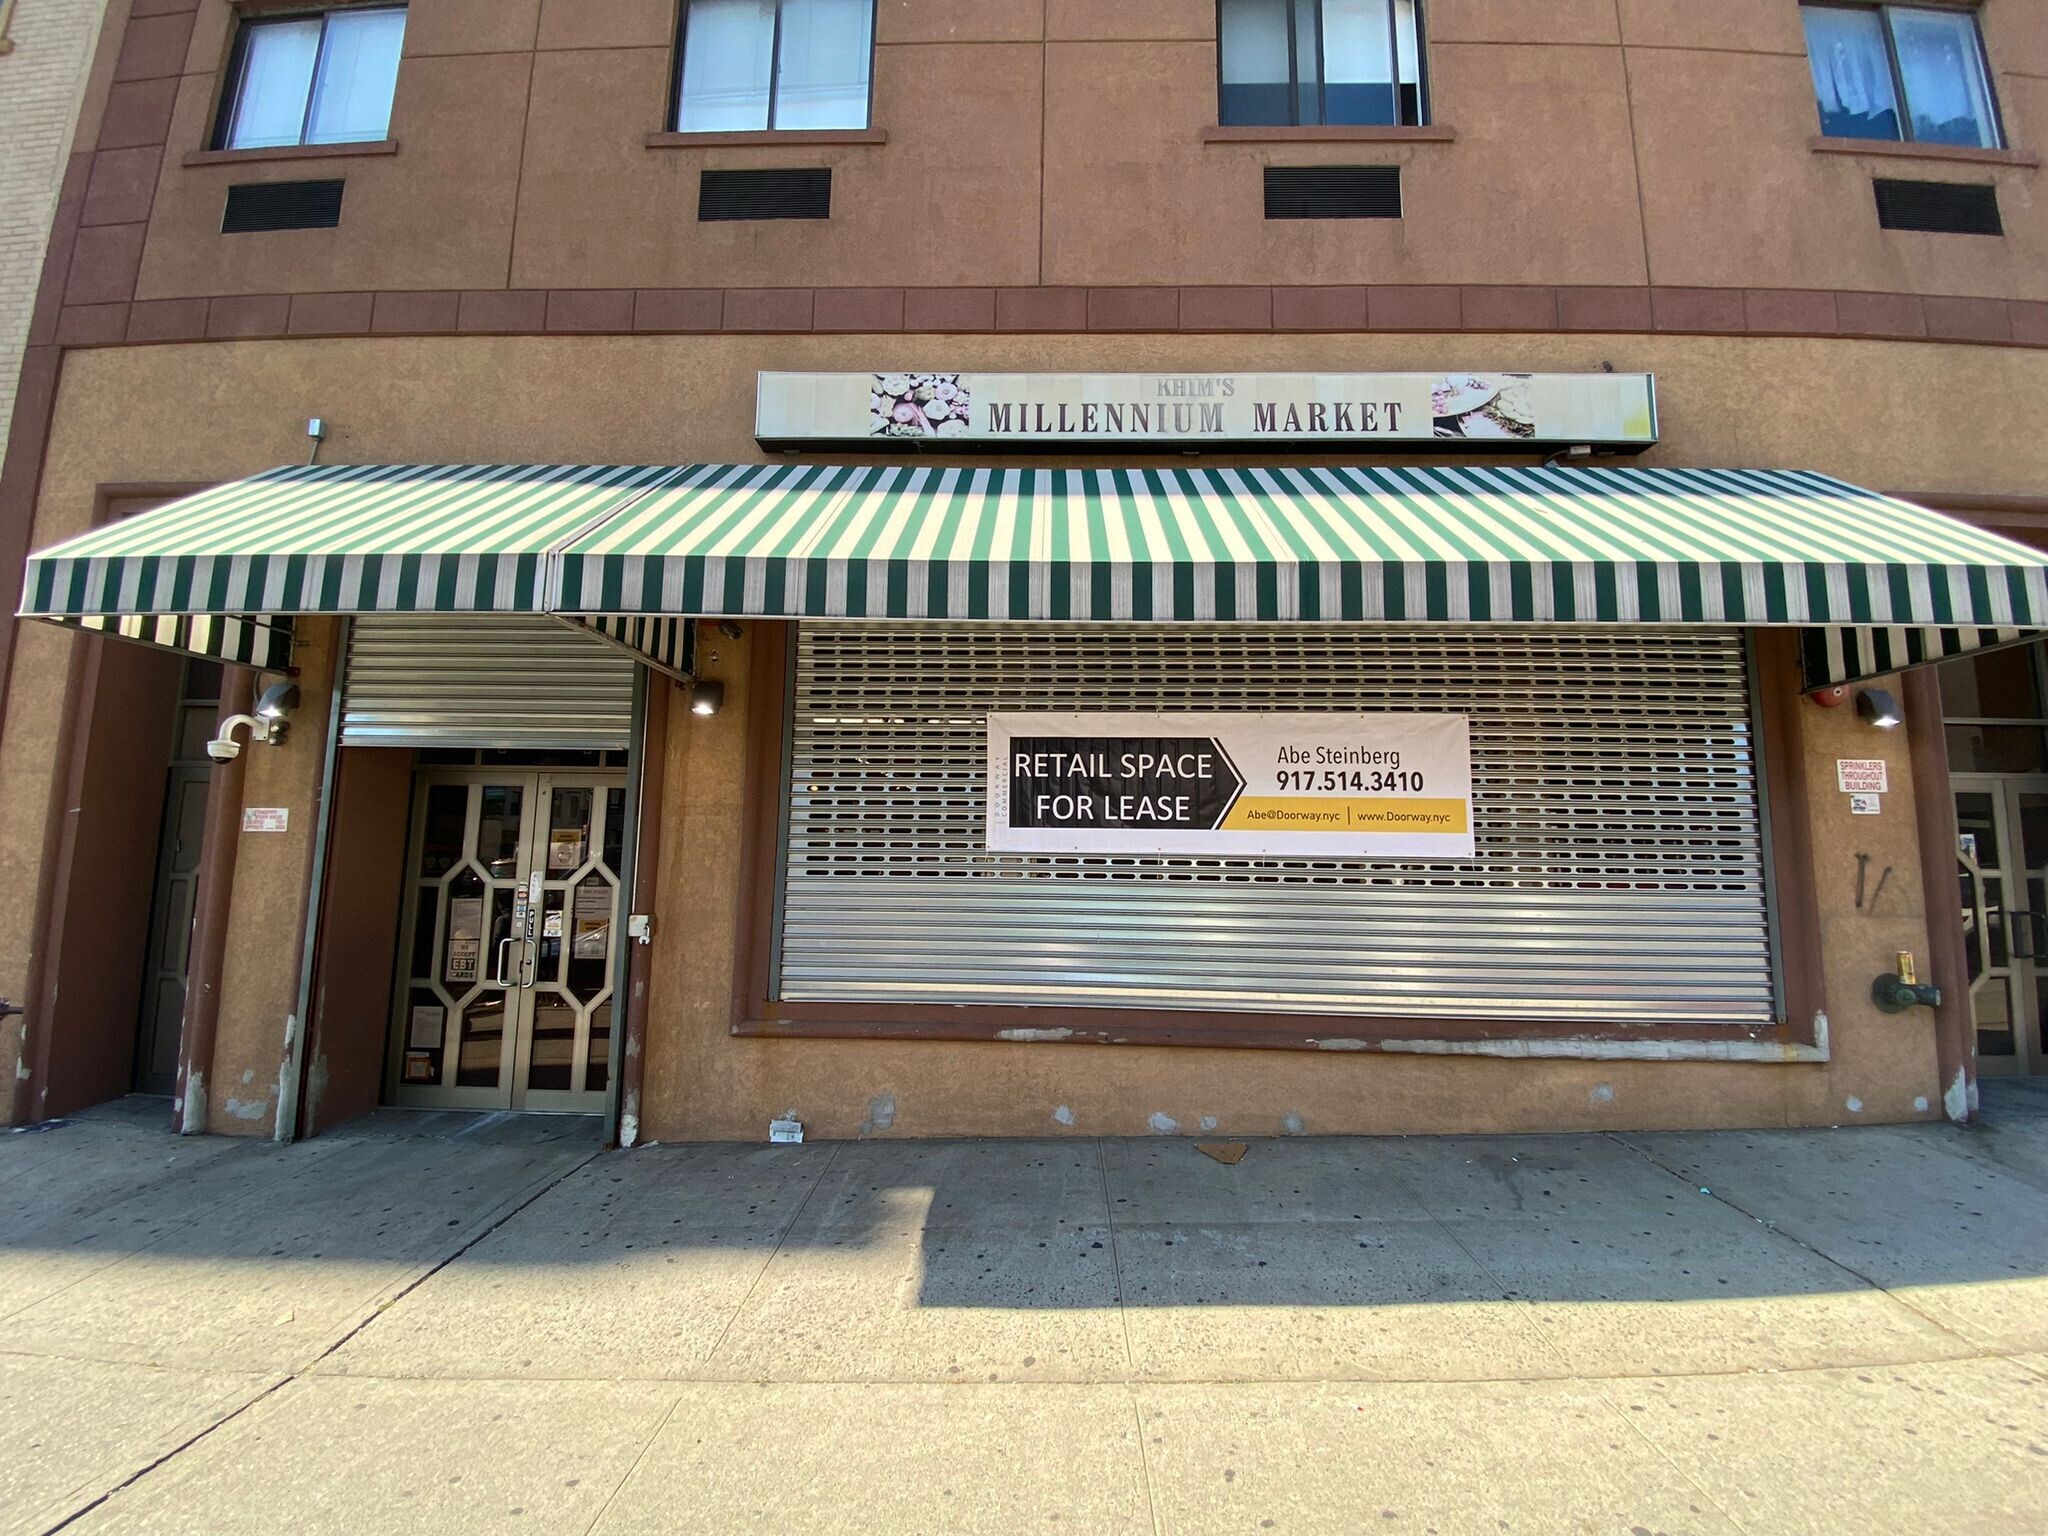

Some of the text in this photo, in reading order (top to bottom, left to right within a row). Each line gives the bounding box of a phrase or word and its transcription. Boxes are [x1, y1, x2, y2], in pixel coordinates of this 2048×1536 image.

[1156, 378, 1235, 397] KHIM'S
[988, 402, 1402, 433] MILLENNIUM MARKET
[1014, 753, 1213, 779] RETAIL SPACE
[1277, 745, 1401, 770] Abe Steinberg
[1840, 761, 1883, 770] SPRINKLERS
[1276, 771, 1424, 792] 917.514.3410
[1841, 771, 1883, 780] THROUGHOUT
[1845, 781, 1881, 790] BUILDING
[1036, 794, 1191, 821] FOR LEASE
[1246, 809, 1451, 823] Abe@Doorway.nyc www.Doorway.nyc
[452, 959, 474, 969] EBT
